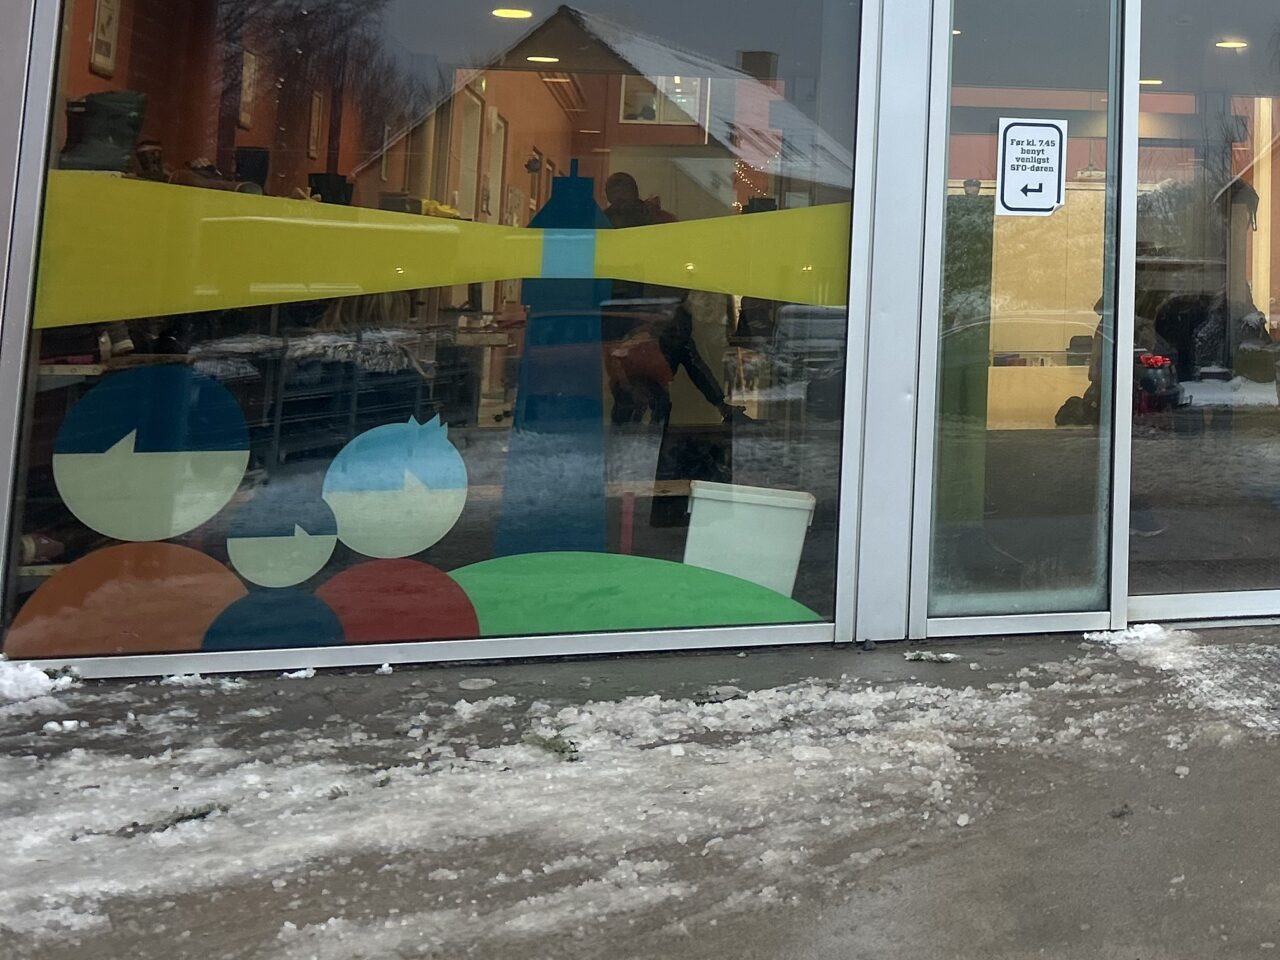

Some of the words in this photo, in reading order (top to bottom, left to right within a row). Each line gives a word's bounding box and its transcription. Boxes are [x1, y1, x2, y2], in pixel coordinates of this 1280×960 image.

[1020, 147, 1045, 156] benyt
[1015, 156, 1050, 164] venligst
[1010, 164, 1054, 172] SFO-døren
